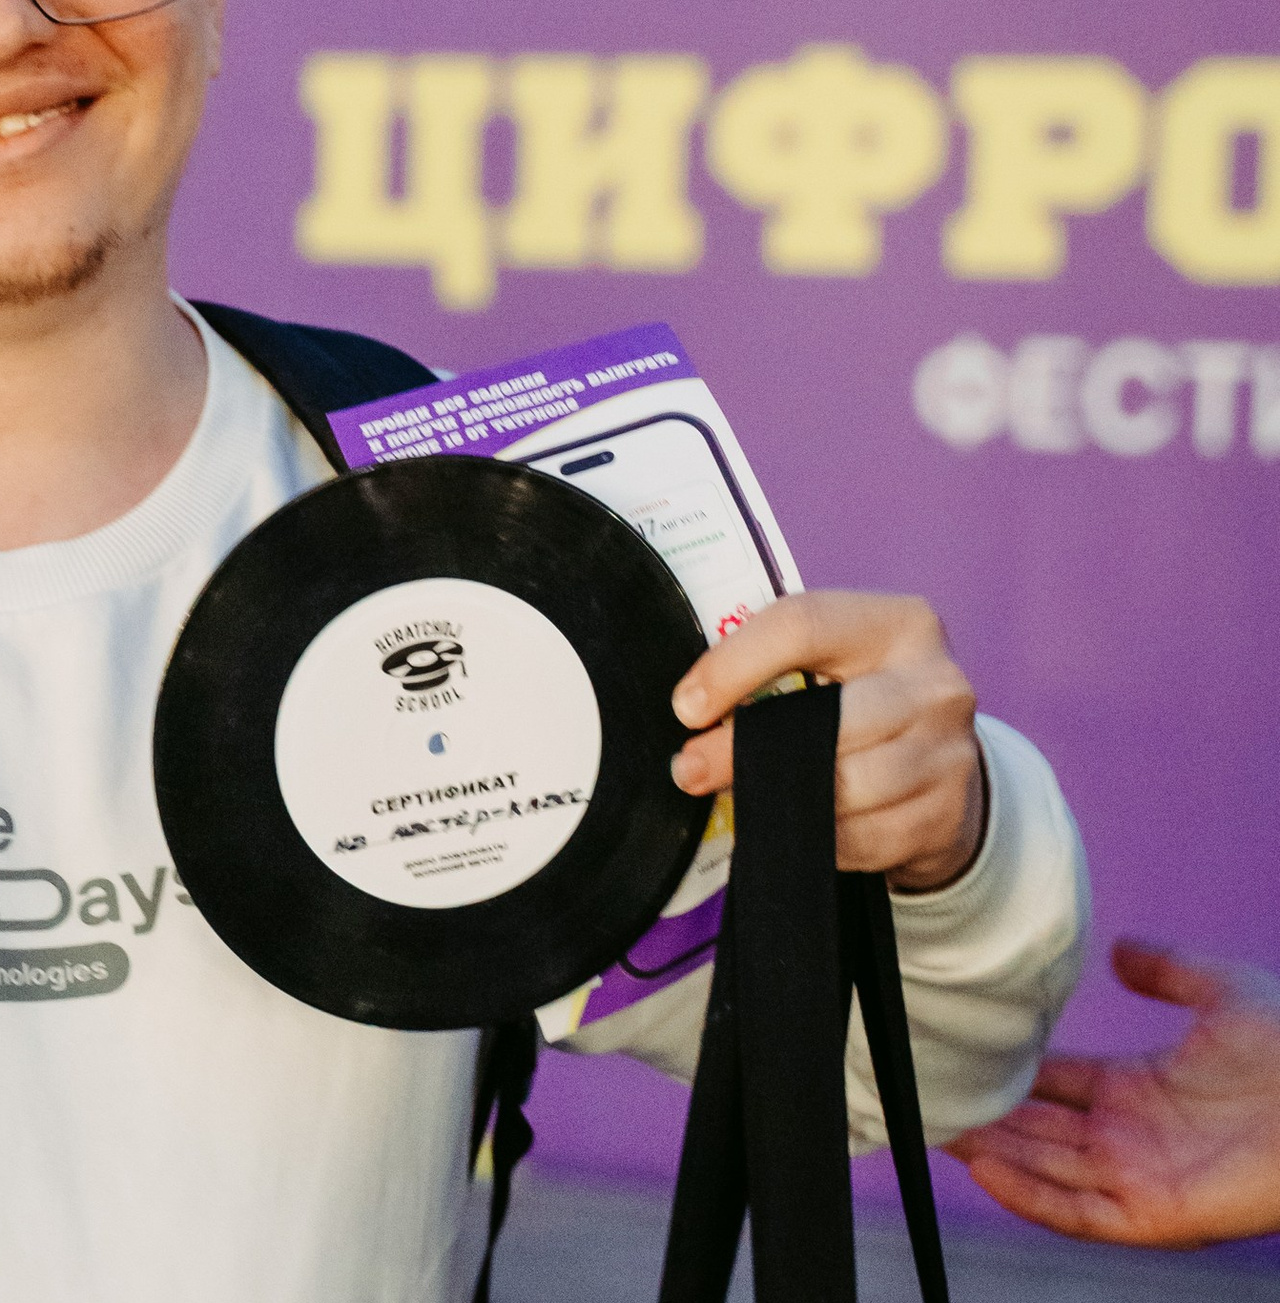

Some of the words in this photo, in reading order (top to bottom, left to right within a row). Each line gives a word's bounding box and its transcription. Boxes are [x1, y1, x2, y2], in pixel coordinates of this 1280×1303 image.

[359, 404, 433, 438] ПРОЙДИ
[467, 370, 548, 404] ЗАДАНИЯ
[384, 414, 459, 450] ПОЛУЧИ
[458, 378, 586, 426] ВОЗМОЖНОСТЬ
[585, 350, 679, 388] ВЫИГРАТЬ
[371, 771, 520, 815] СЕРТИФИКАТ
